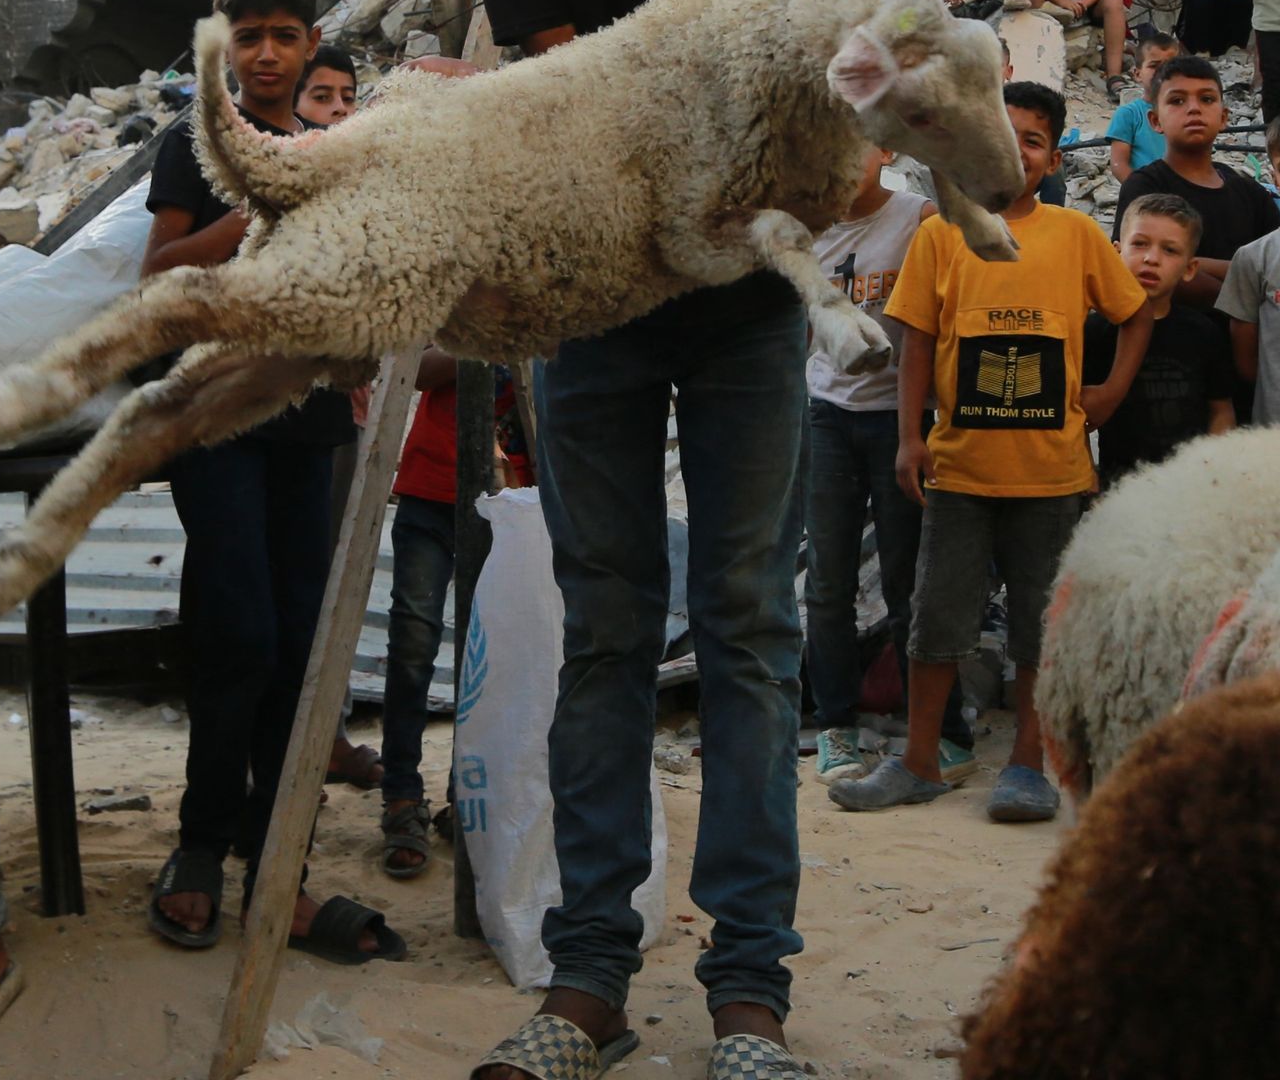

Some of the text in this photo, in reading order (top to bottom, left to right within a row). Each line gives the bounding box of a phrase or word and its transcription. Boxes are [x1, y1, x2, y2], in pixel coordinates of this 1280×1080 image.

[988, 308, 1044, 320] RACE
[988, 320, 1044, 331] LIFE
[1004, 346, 1019, 406] RUN TOGETHER
[960, 406, 1055, 418] RUN THDM STYLE
